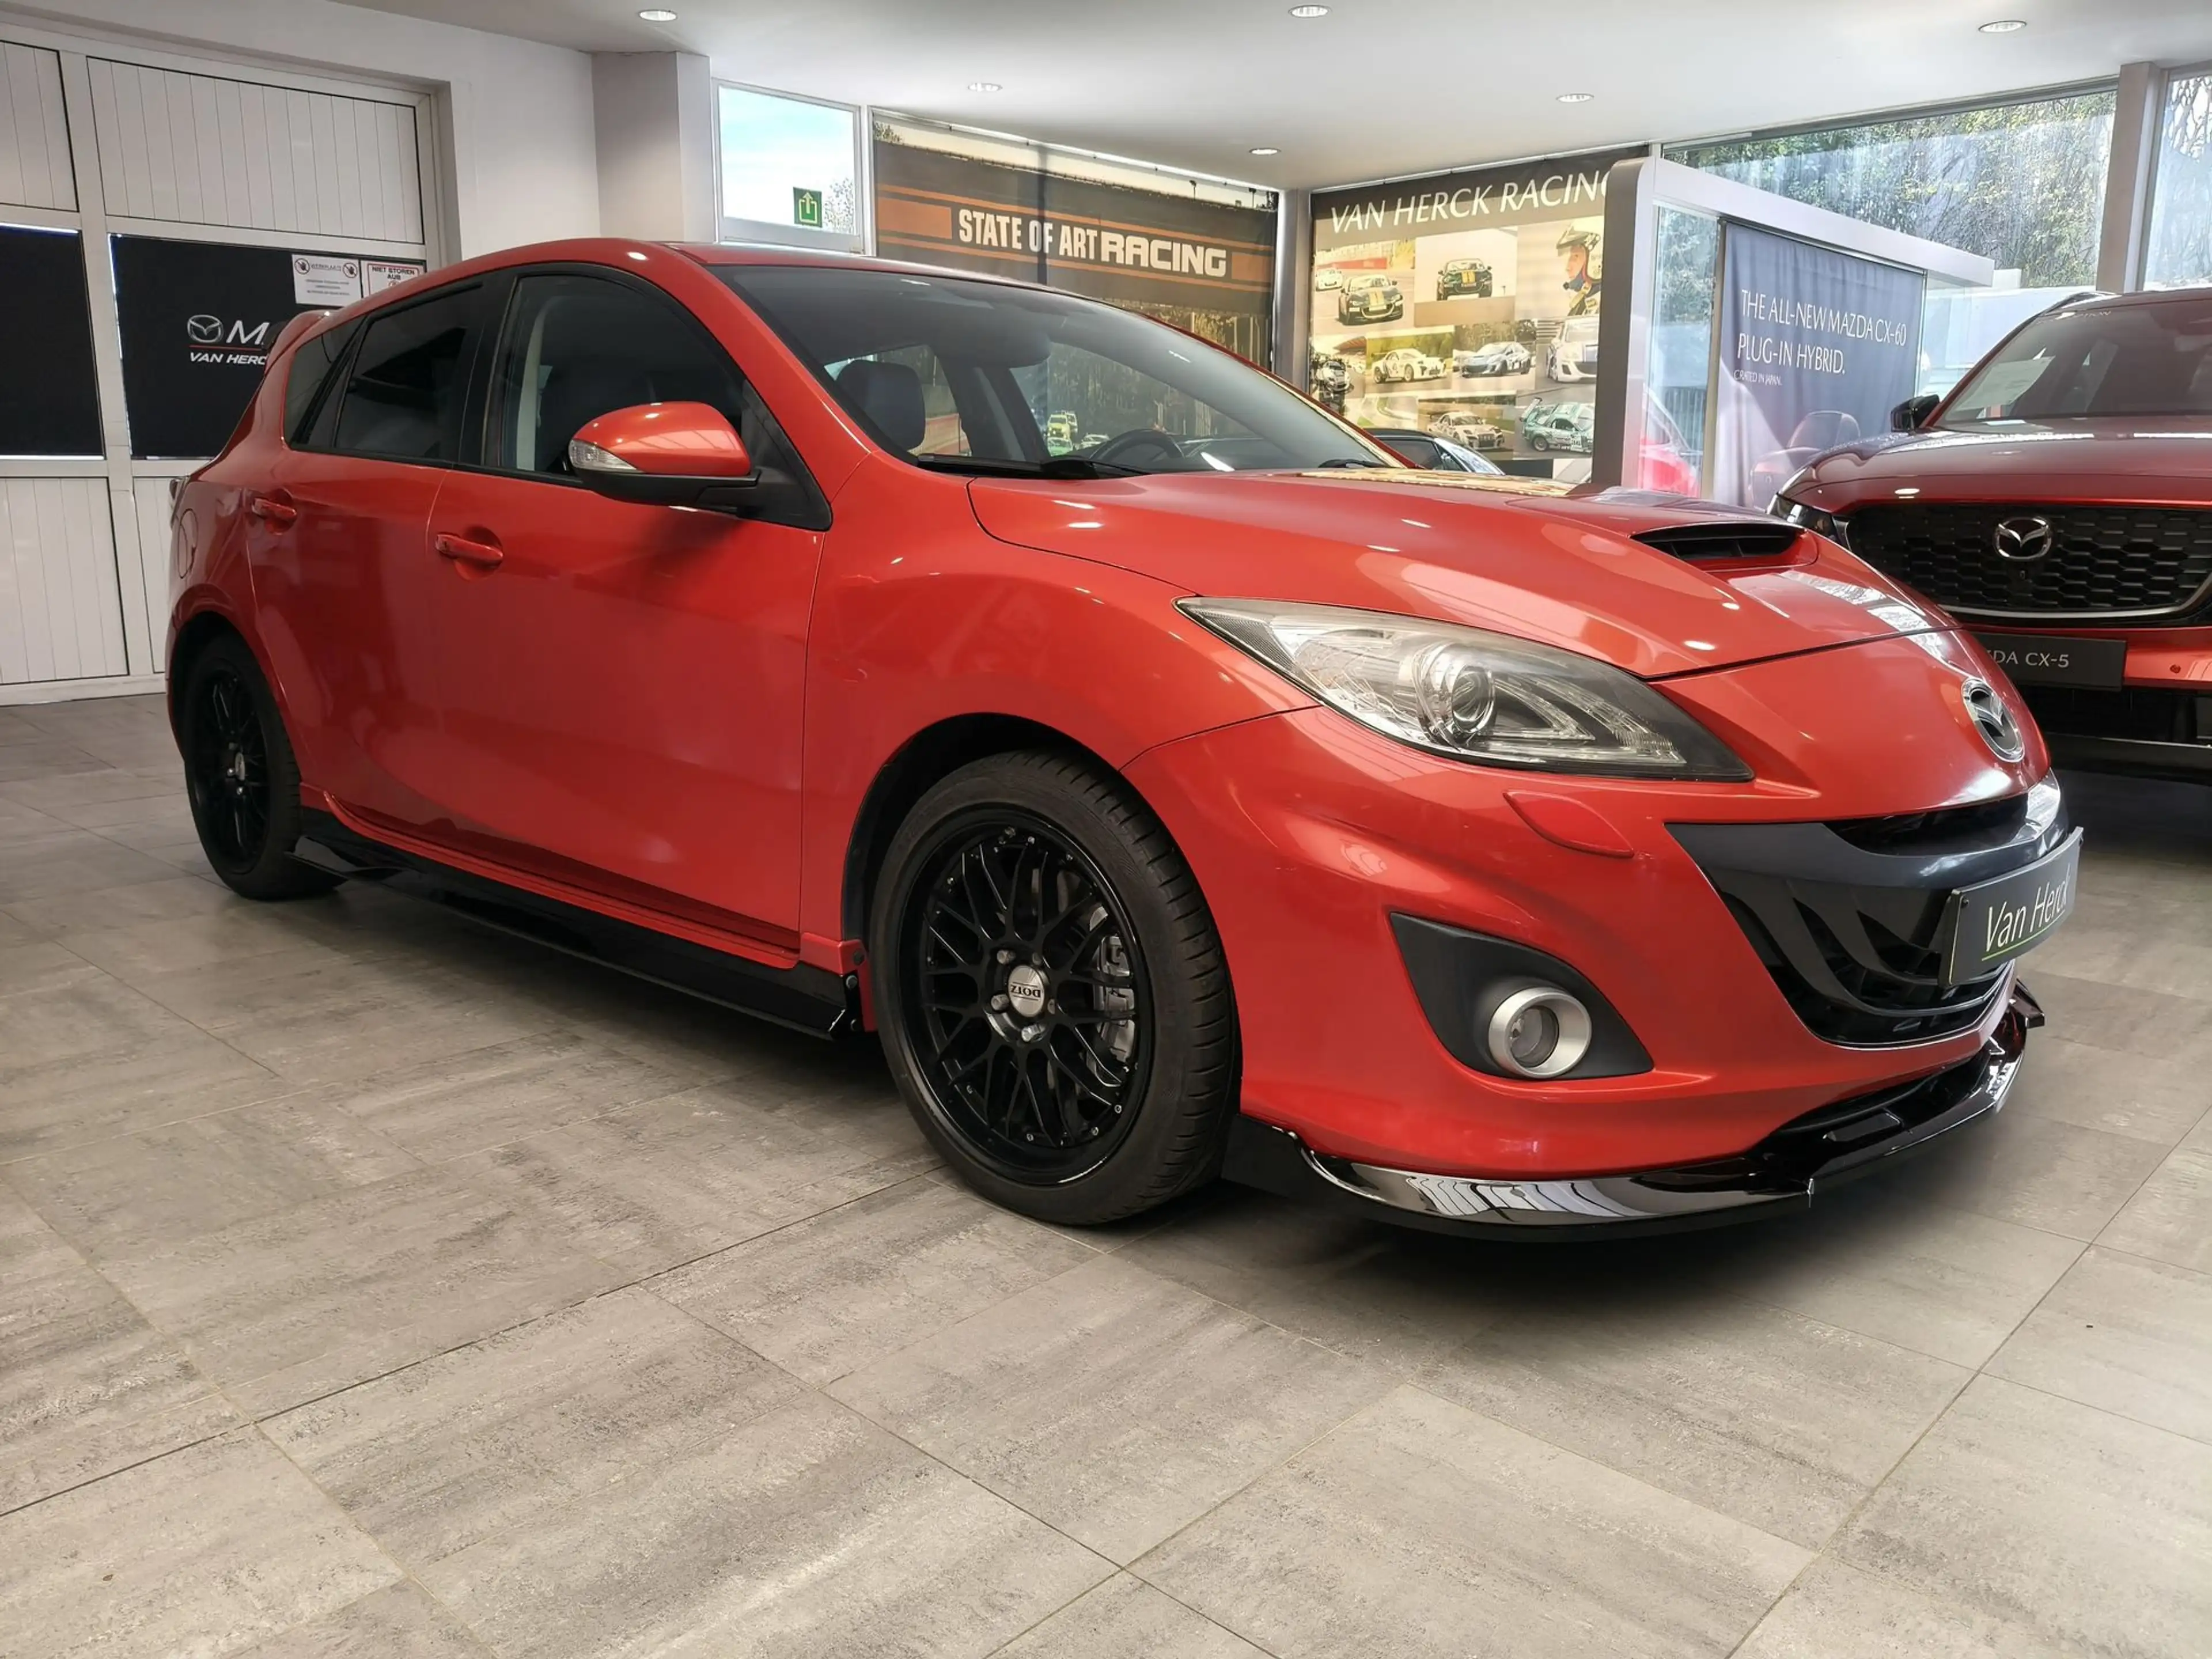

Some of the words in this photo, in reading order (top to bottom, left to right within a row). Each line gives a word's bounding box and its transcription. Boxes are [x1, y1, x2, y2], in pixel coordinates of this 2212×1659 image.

[1331, 200, 1385, 233] VAN
[1393, 184, 1493, 225] HERCK
[959, 209, 1022, 250] STATE
[1029, 220, 1053, 253] OF
[1059, 225, 1097, 260] ART
[1100, 233, 1226, 278] RACING
[226, 320, 270, 345] M
[1741, 289, 1766, 320] THE
[1768, 297, 1827, 331] ALL-NEW
[1827, 309, 1873, 340] MAZDA
[1875, 319, 1907, 346] CX-60
[190, 352, 224, 363] VAN
[1737, 333, 1793, 367] PLUG-IN
[1796, 343, 1846, 374] HYBRID.
[2025, 652, 2069, 668] CX-5
[1986, 901, 2027, 952] Van
[2029, 863, 2071, 933] Herck
[1010, 984, 1041, 998] DOTZ
